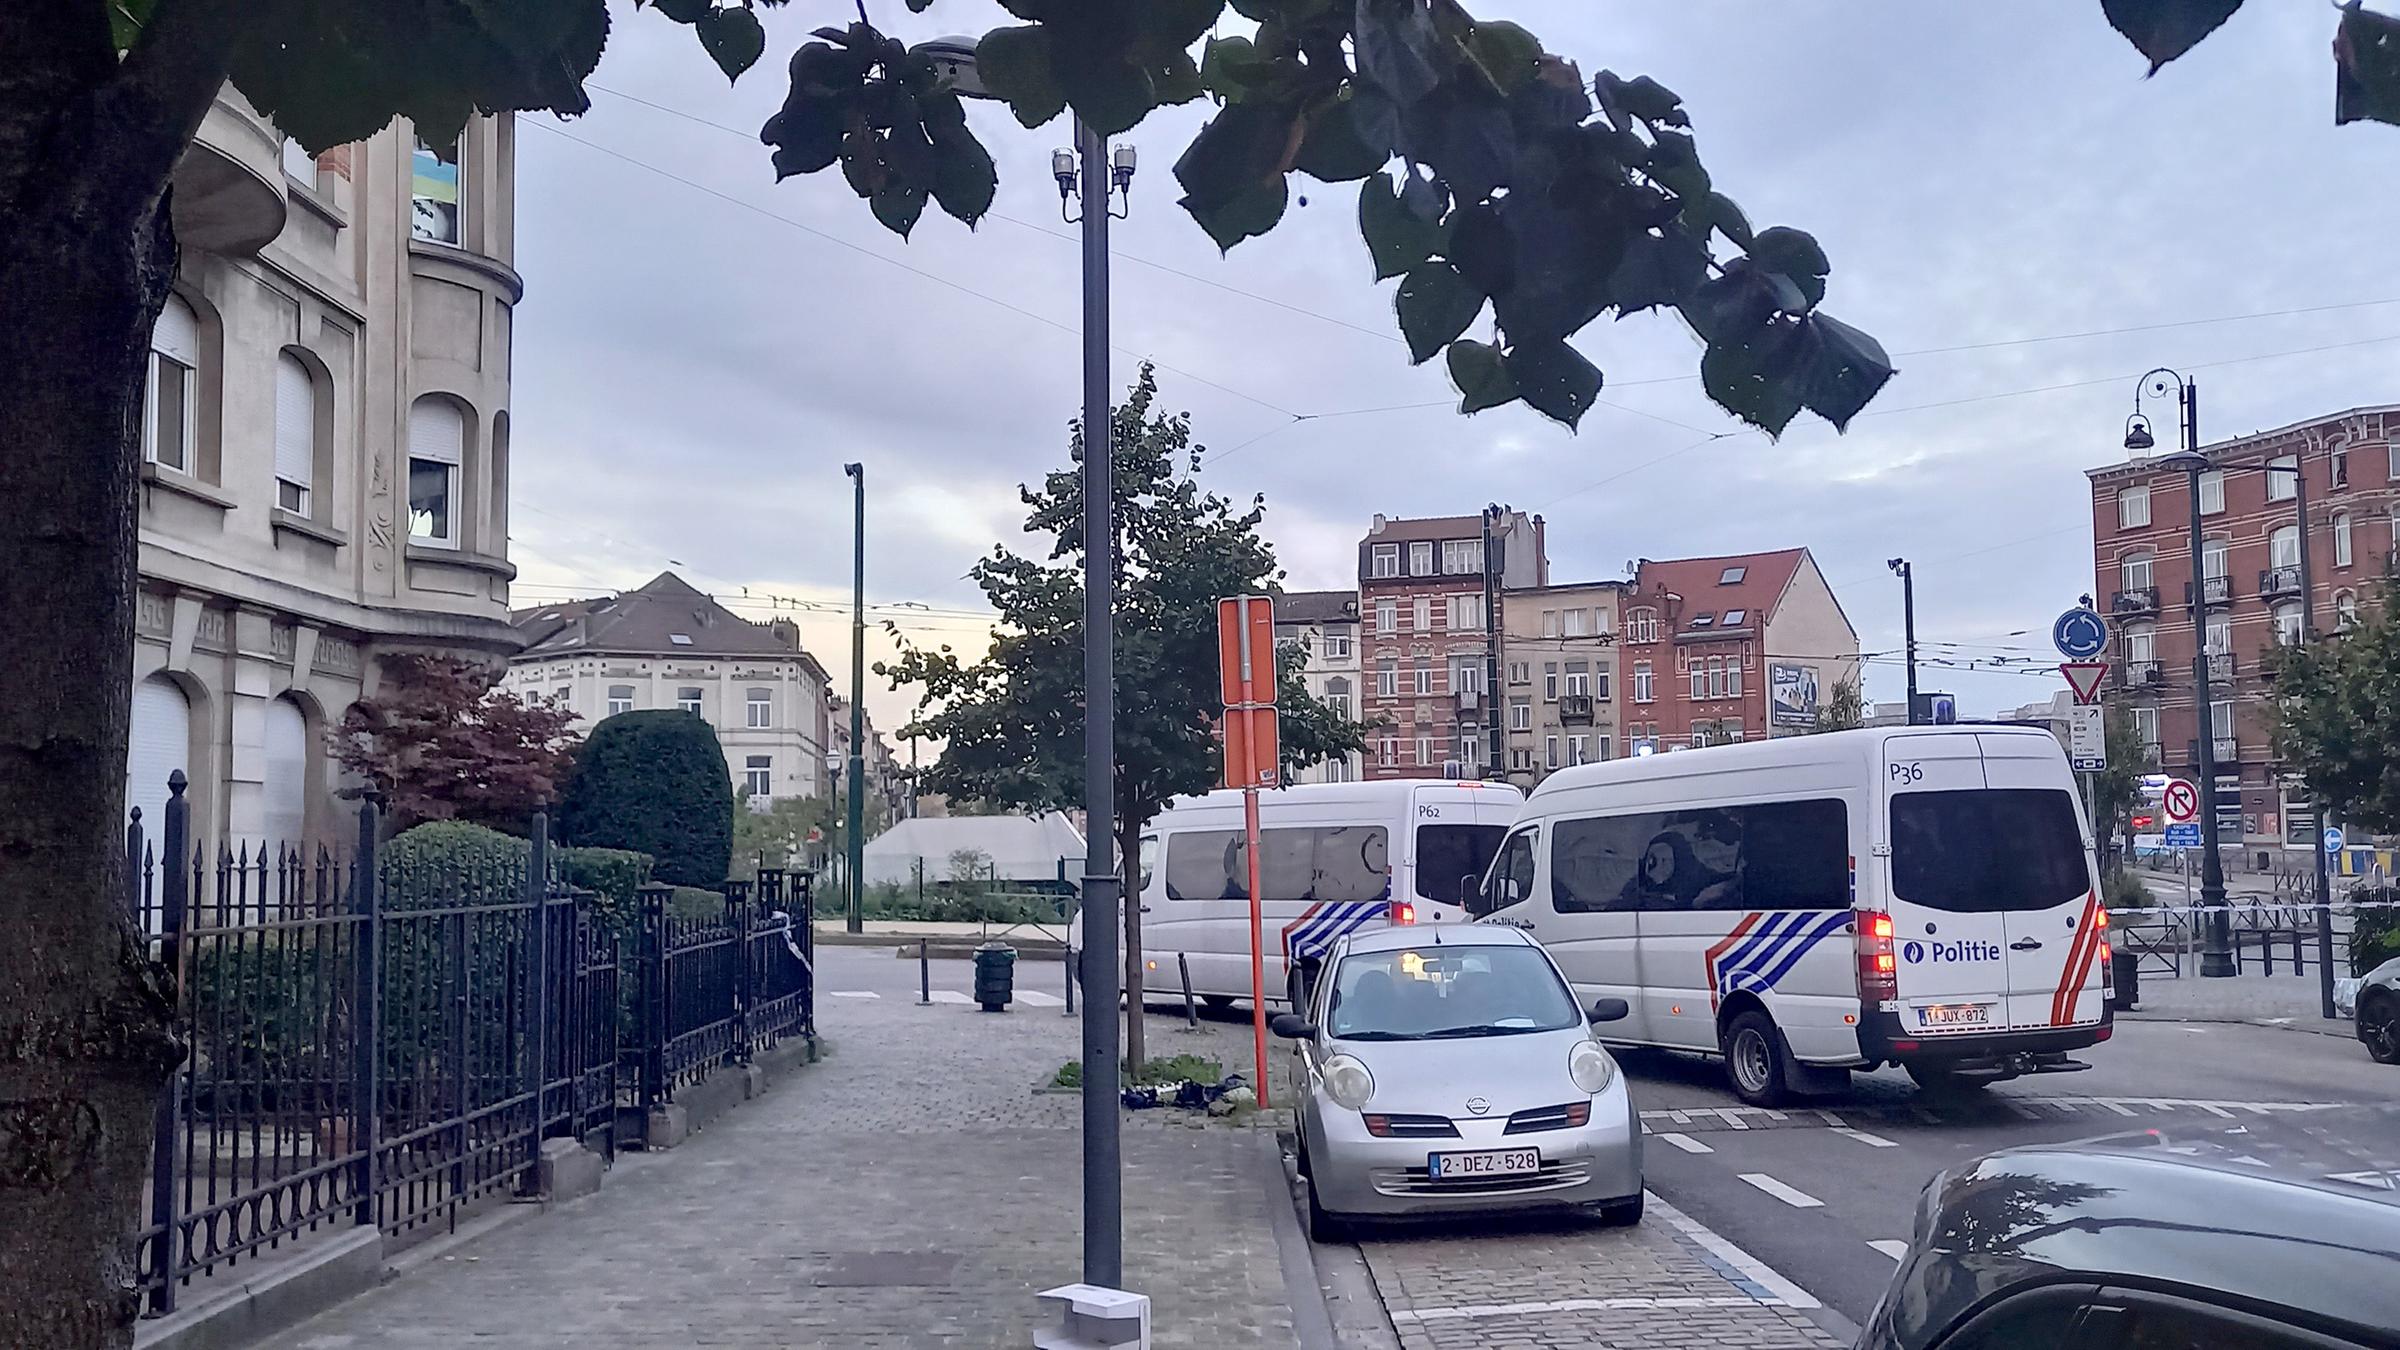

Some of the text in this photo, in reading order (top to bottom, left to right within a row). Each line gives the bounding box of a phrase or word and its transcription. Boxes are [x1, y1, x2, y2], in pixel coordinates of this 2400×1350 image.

[1890, 762, 1923, 785] P36
[1419, 805, 1440, 818] P62
[1932, 940, 2000, 962] Politie
[1442, 1153, 1535, 1173] 2-DEZ-528
